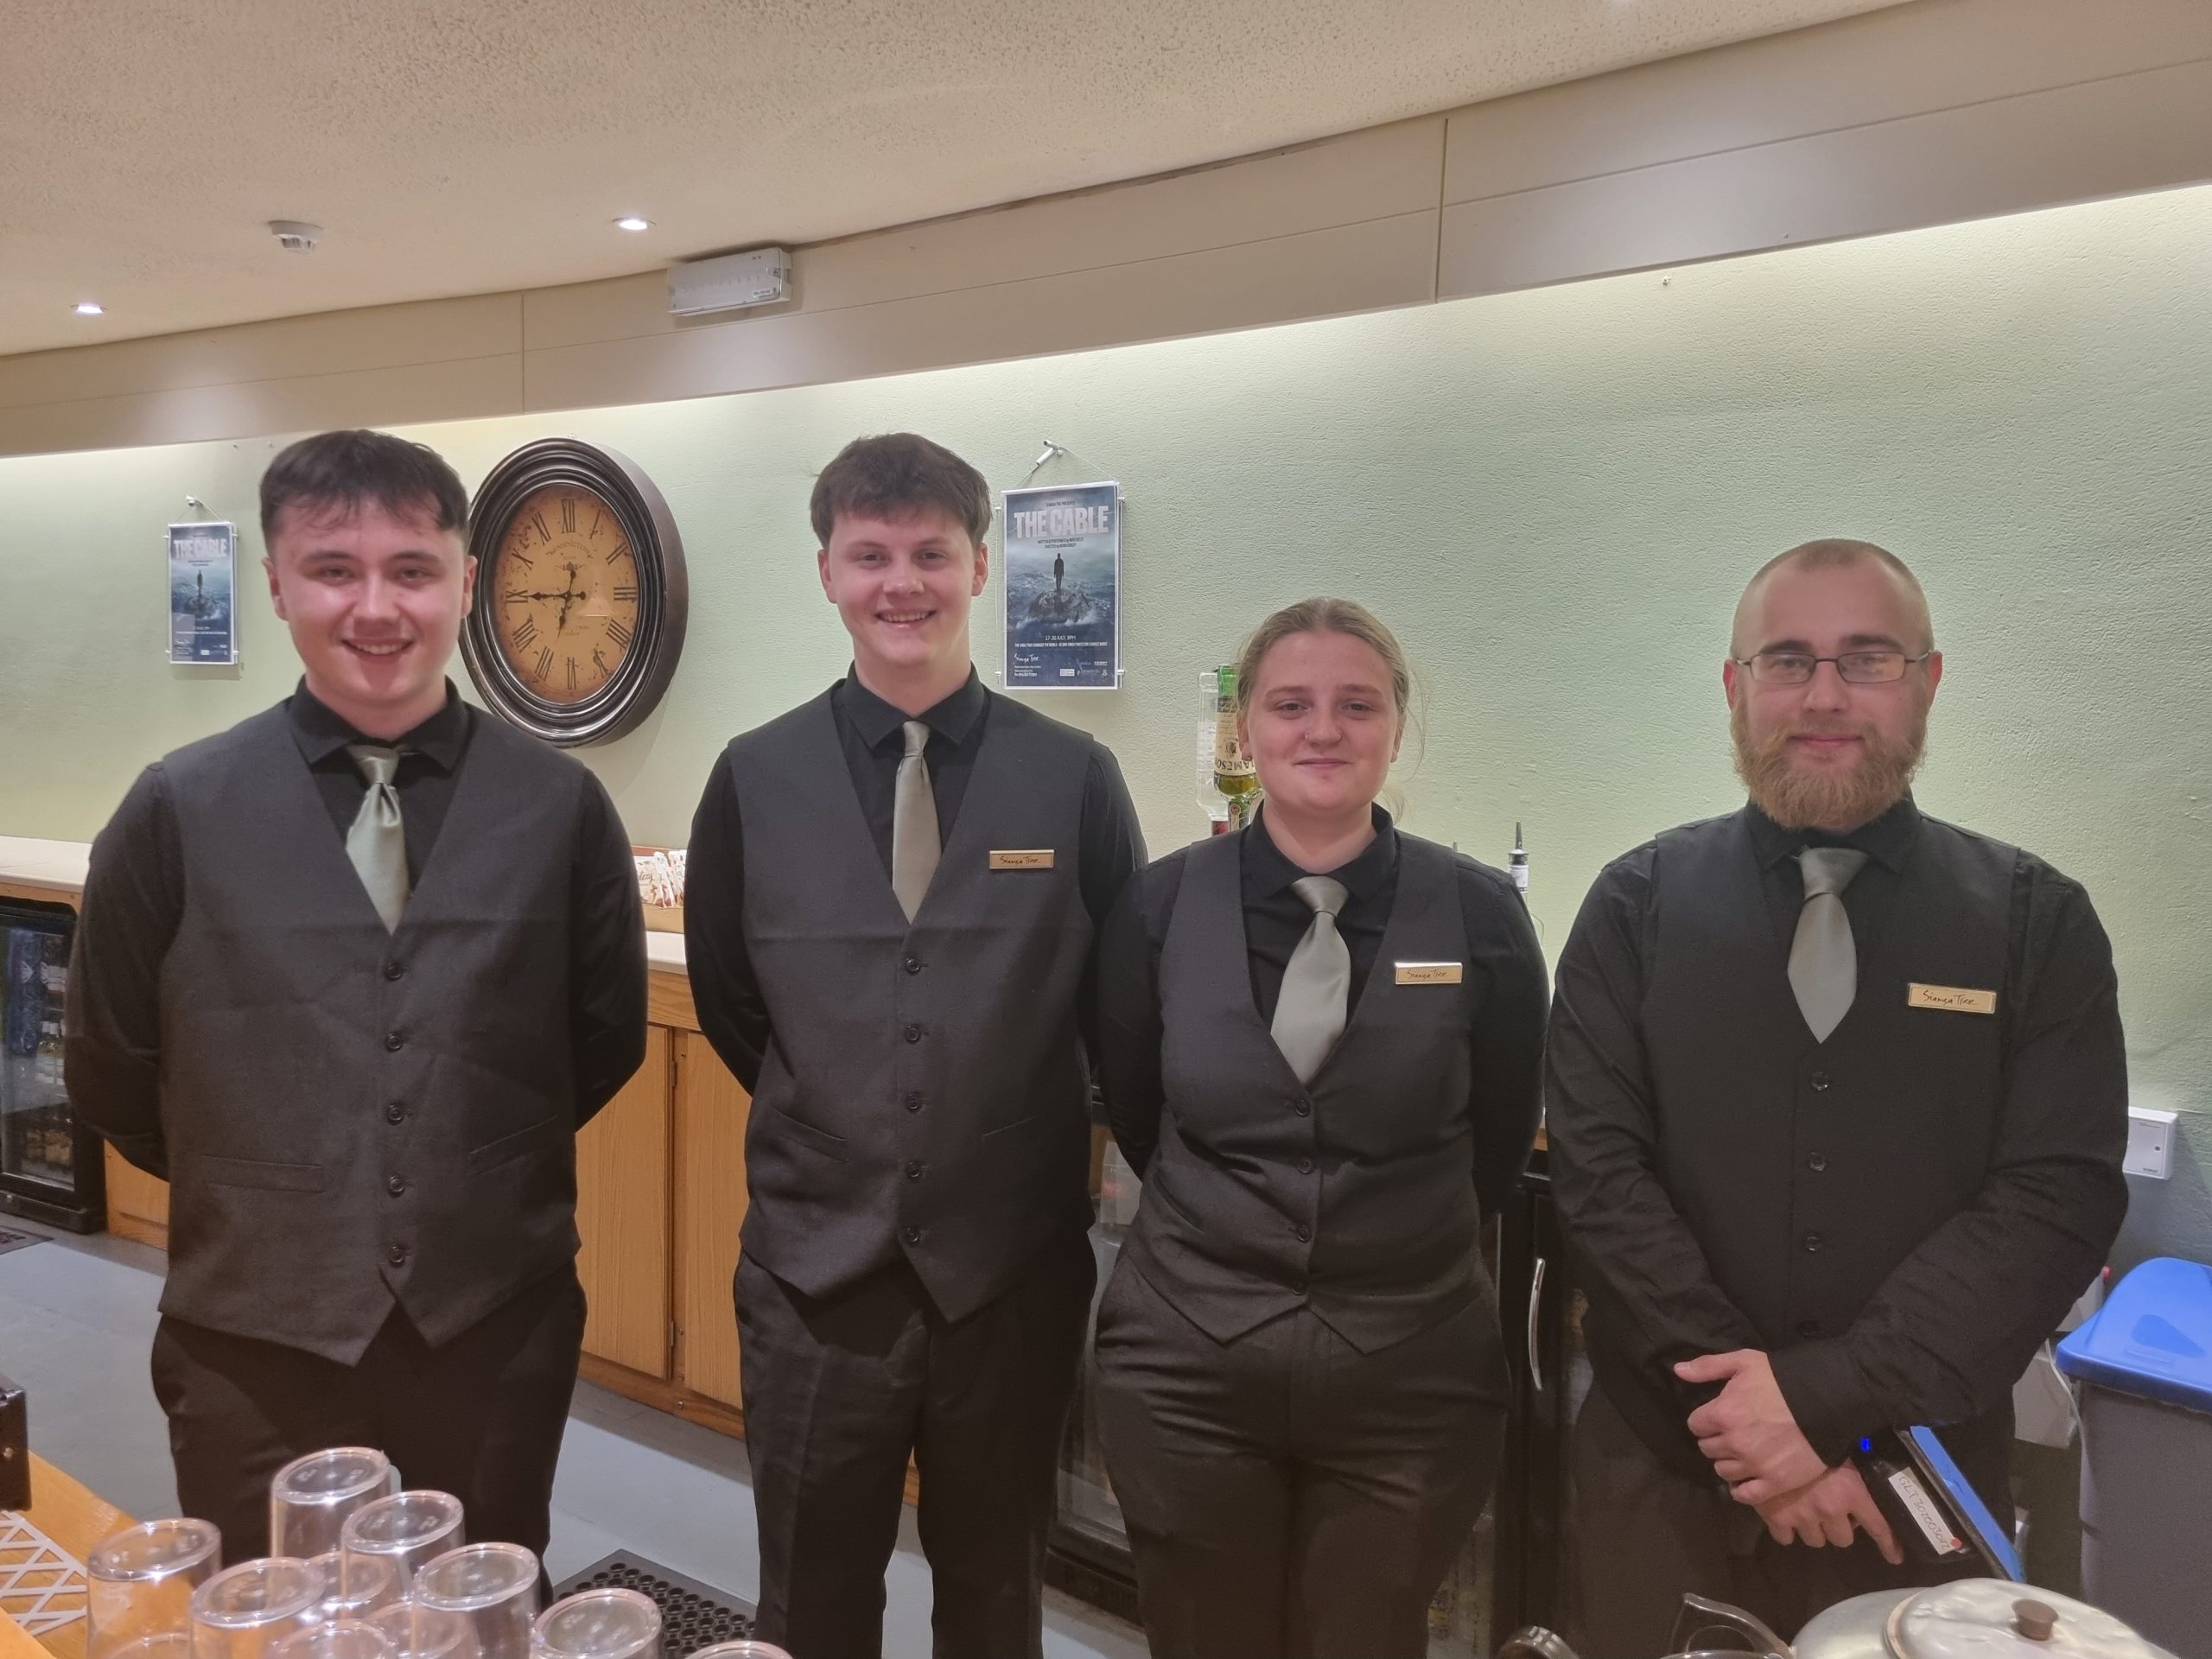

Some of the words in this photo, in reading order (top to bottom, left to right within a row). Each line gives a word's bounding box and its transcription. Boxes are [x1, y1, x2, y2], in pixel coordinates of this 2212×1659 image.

[1014, 510, 1047, 539] THE
[1050, 505, 1109, 536] CABLE
[1215, 759, 1254, 771] AMESO
